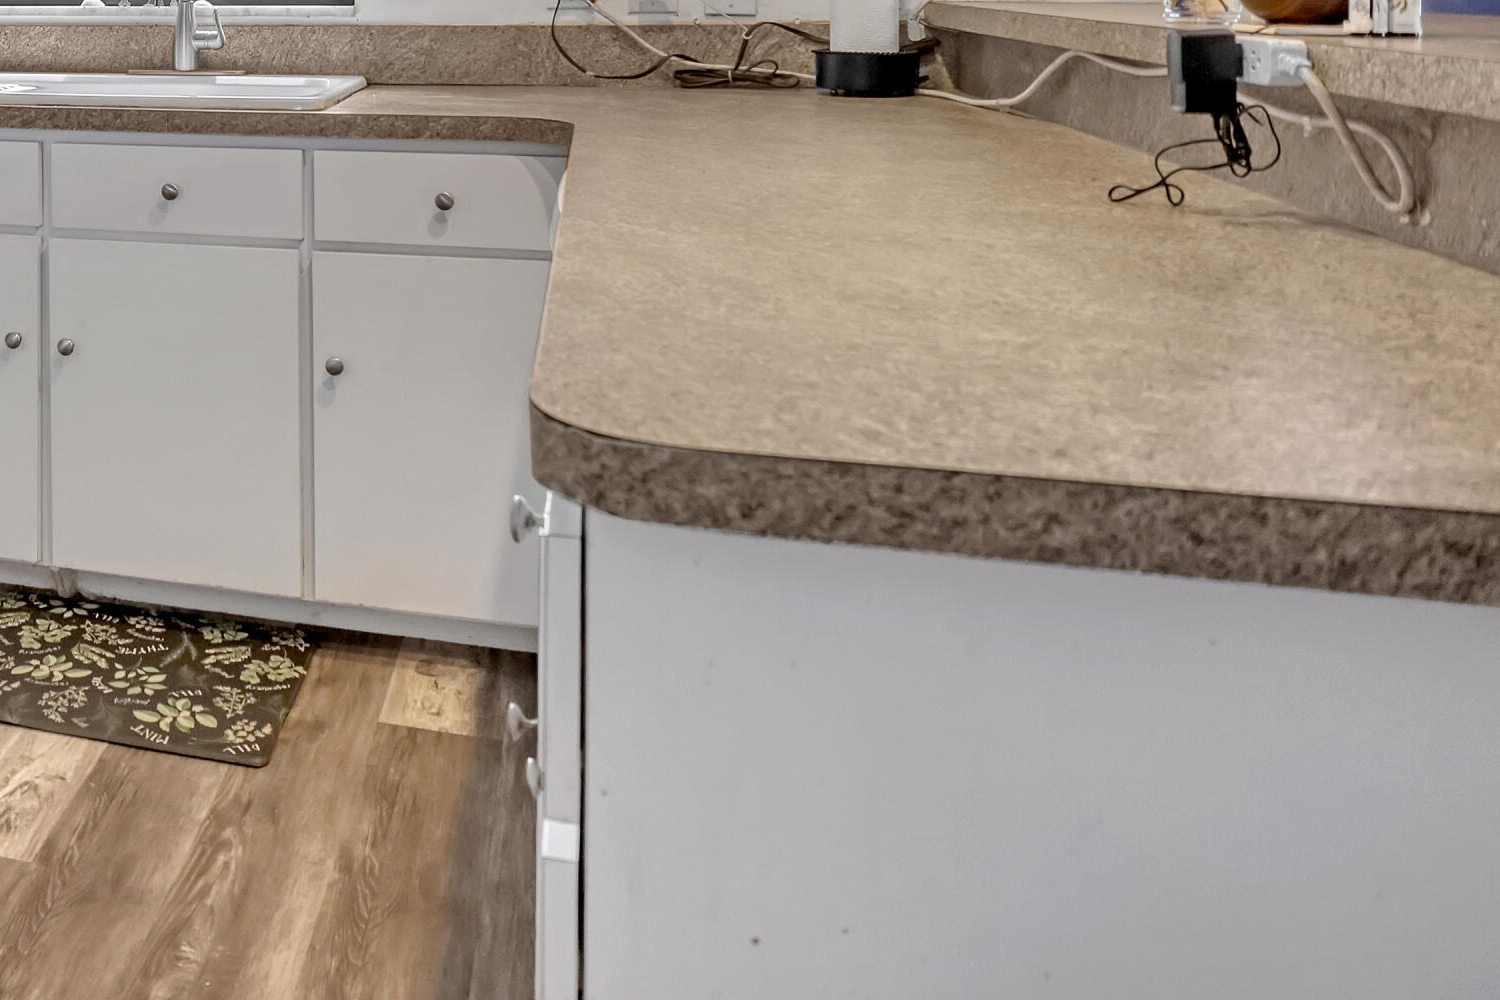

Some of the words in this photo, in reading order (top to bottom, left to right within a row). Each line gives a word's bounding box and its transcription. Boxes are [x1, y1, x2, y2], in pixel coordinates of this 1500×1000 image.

[115, 643, 169, 655] THYME
[130, 724, 170, 745] MINT
[222, 743, 261, 755] DILL
